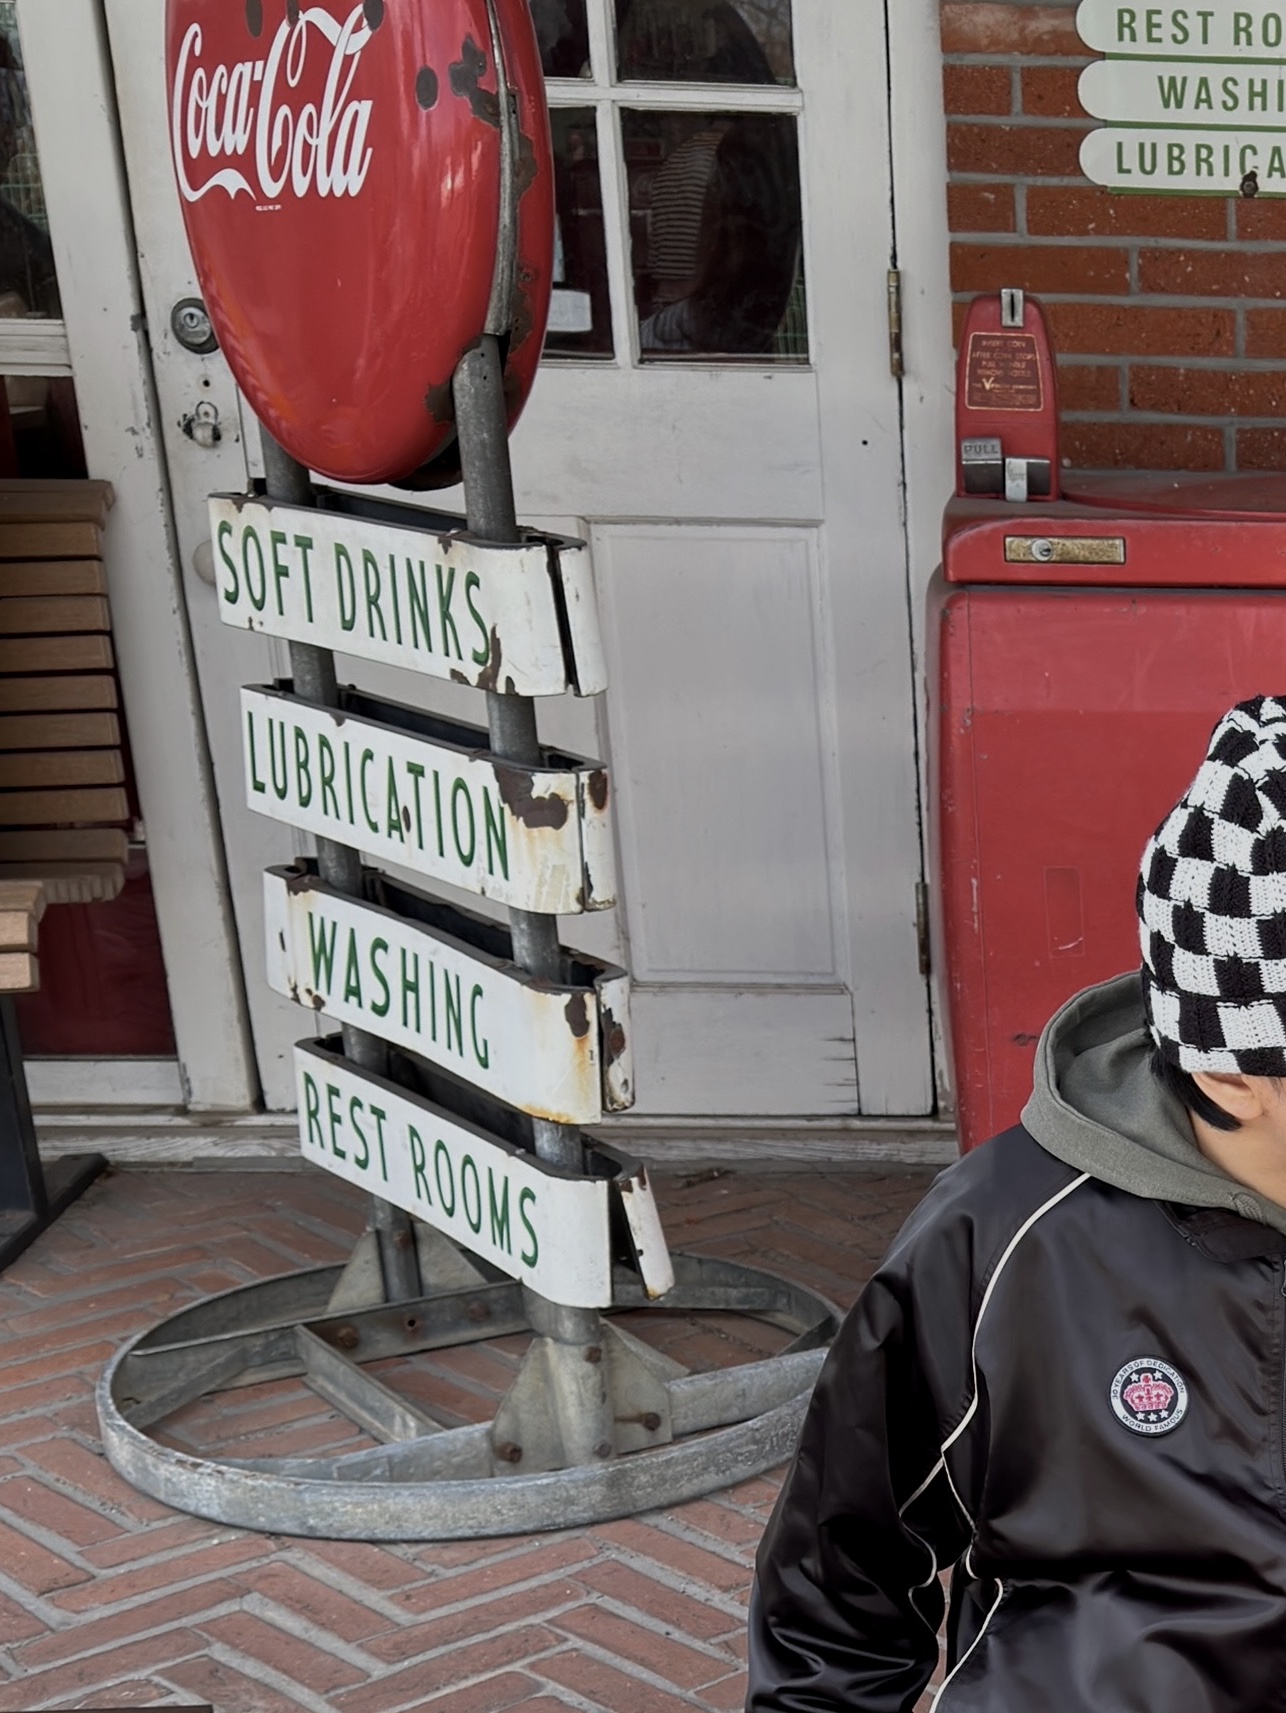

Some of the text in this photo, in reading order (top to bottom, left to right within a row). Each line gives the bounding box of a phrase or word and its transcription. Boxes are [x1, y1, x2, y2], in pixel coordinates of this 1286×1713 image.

[1116, 8, 1214, 45] REST
[173, 3, 374, 202] Coca-Cola
[964, 444, 999, 454] PULL
[217, 520, 490, 666] SOFT DRINKS
[247, 711, 509, 881] LUBRICATION
[307, 911, 490, 1070] WASHING
[303, 1071, 539, 1269] REST ROOMS
[1113, 1364, 1134, 1389] YEARS
[1133, 1360, 1145, 1368] OF
[1146, 1360, 1185, 1393] DEDICATION
[1122, 1409, 1183, 1432] WORLD FAMOUS
